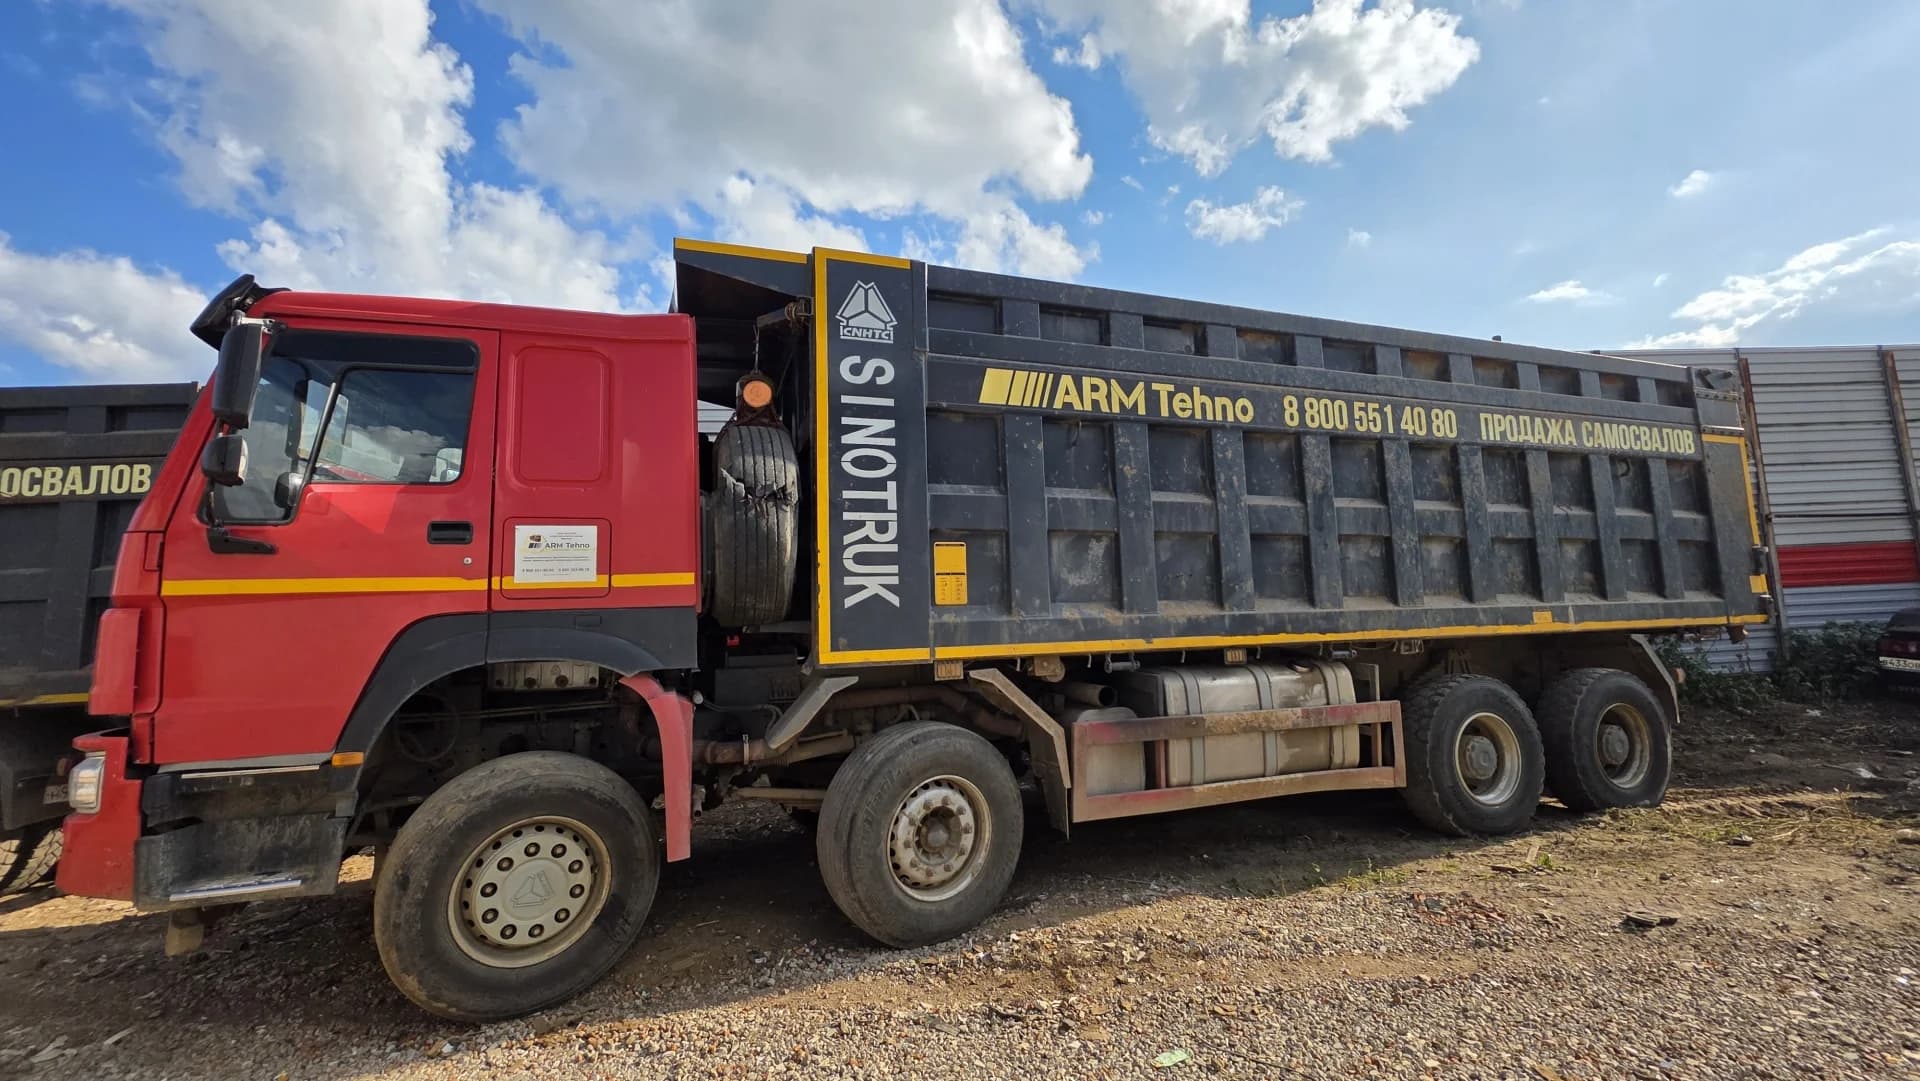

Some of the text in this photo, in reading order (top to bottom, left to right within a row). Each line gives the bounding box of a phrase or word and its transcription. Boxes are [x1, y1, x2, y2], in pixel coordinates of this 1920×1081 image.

[843, 327, 891, 340] CNHTC
[1053, 374, 1256, 424] ARM Tehno
[1283, 395, 1458, 439] 8 800 551 40 80
[1480, 413, 1695, 454] ПРОДАЖА САМОСВАЛОВ
[839, 355, 900, 609] SINOTRUK
